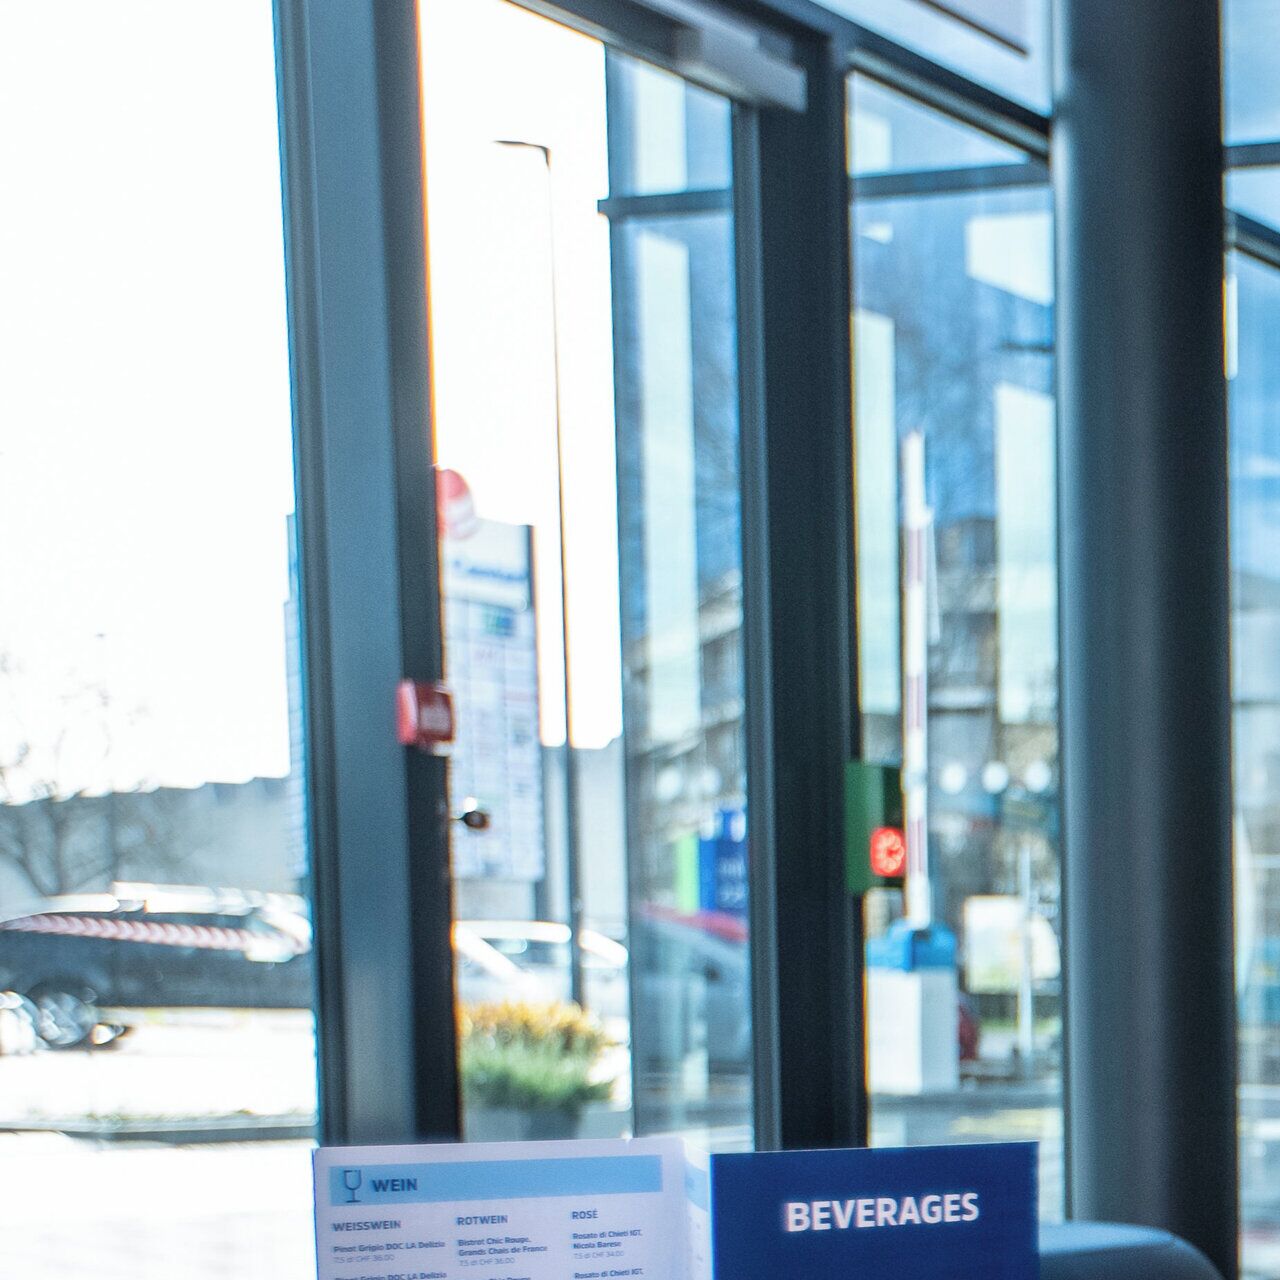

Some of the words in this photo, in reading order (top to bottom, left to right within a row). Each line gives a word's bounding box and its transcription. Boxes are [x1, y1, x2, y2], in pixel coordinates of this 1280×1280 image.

[373, 1178, 418, 1192] WEIN
[572, 1208, 599, 1220] ROSÉ
[786, 1192, 979, 1232] BEVERAGES
[333, 1220, 401, 1231] WEISSWEIN
[457, 1215, 508, 1226] ROTWEIN
